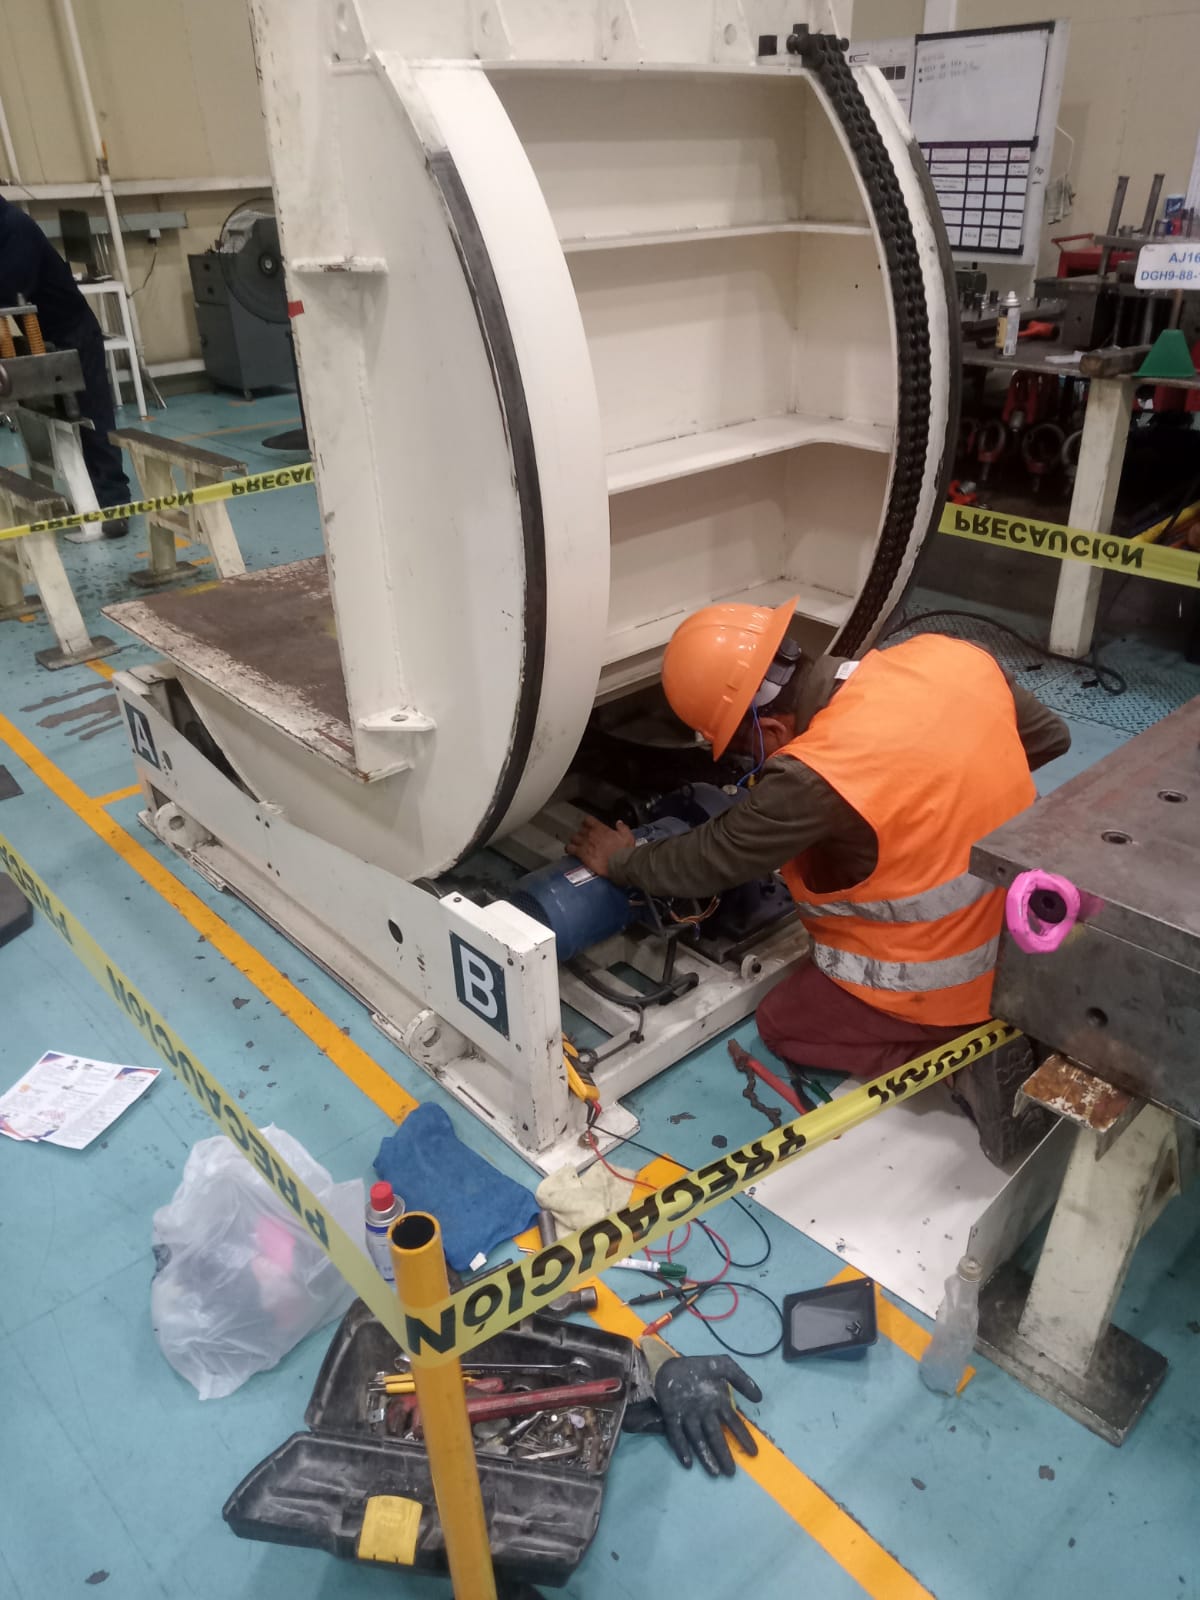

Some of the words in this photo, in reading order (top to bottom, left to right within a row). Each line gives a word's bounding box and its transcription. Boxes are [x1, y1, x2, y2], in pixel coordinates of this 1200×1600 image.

[1141, 270, 1200, 281] DGH9-88-
[133, 712, 158, 764] A
[459, 944, 498, 1019] B
[106, 965, 330, 1250] PRECAUCIÓN
[404, 1127, 807, 1357] PRECAUCIÓN
